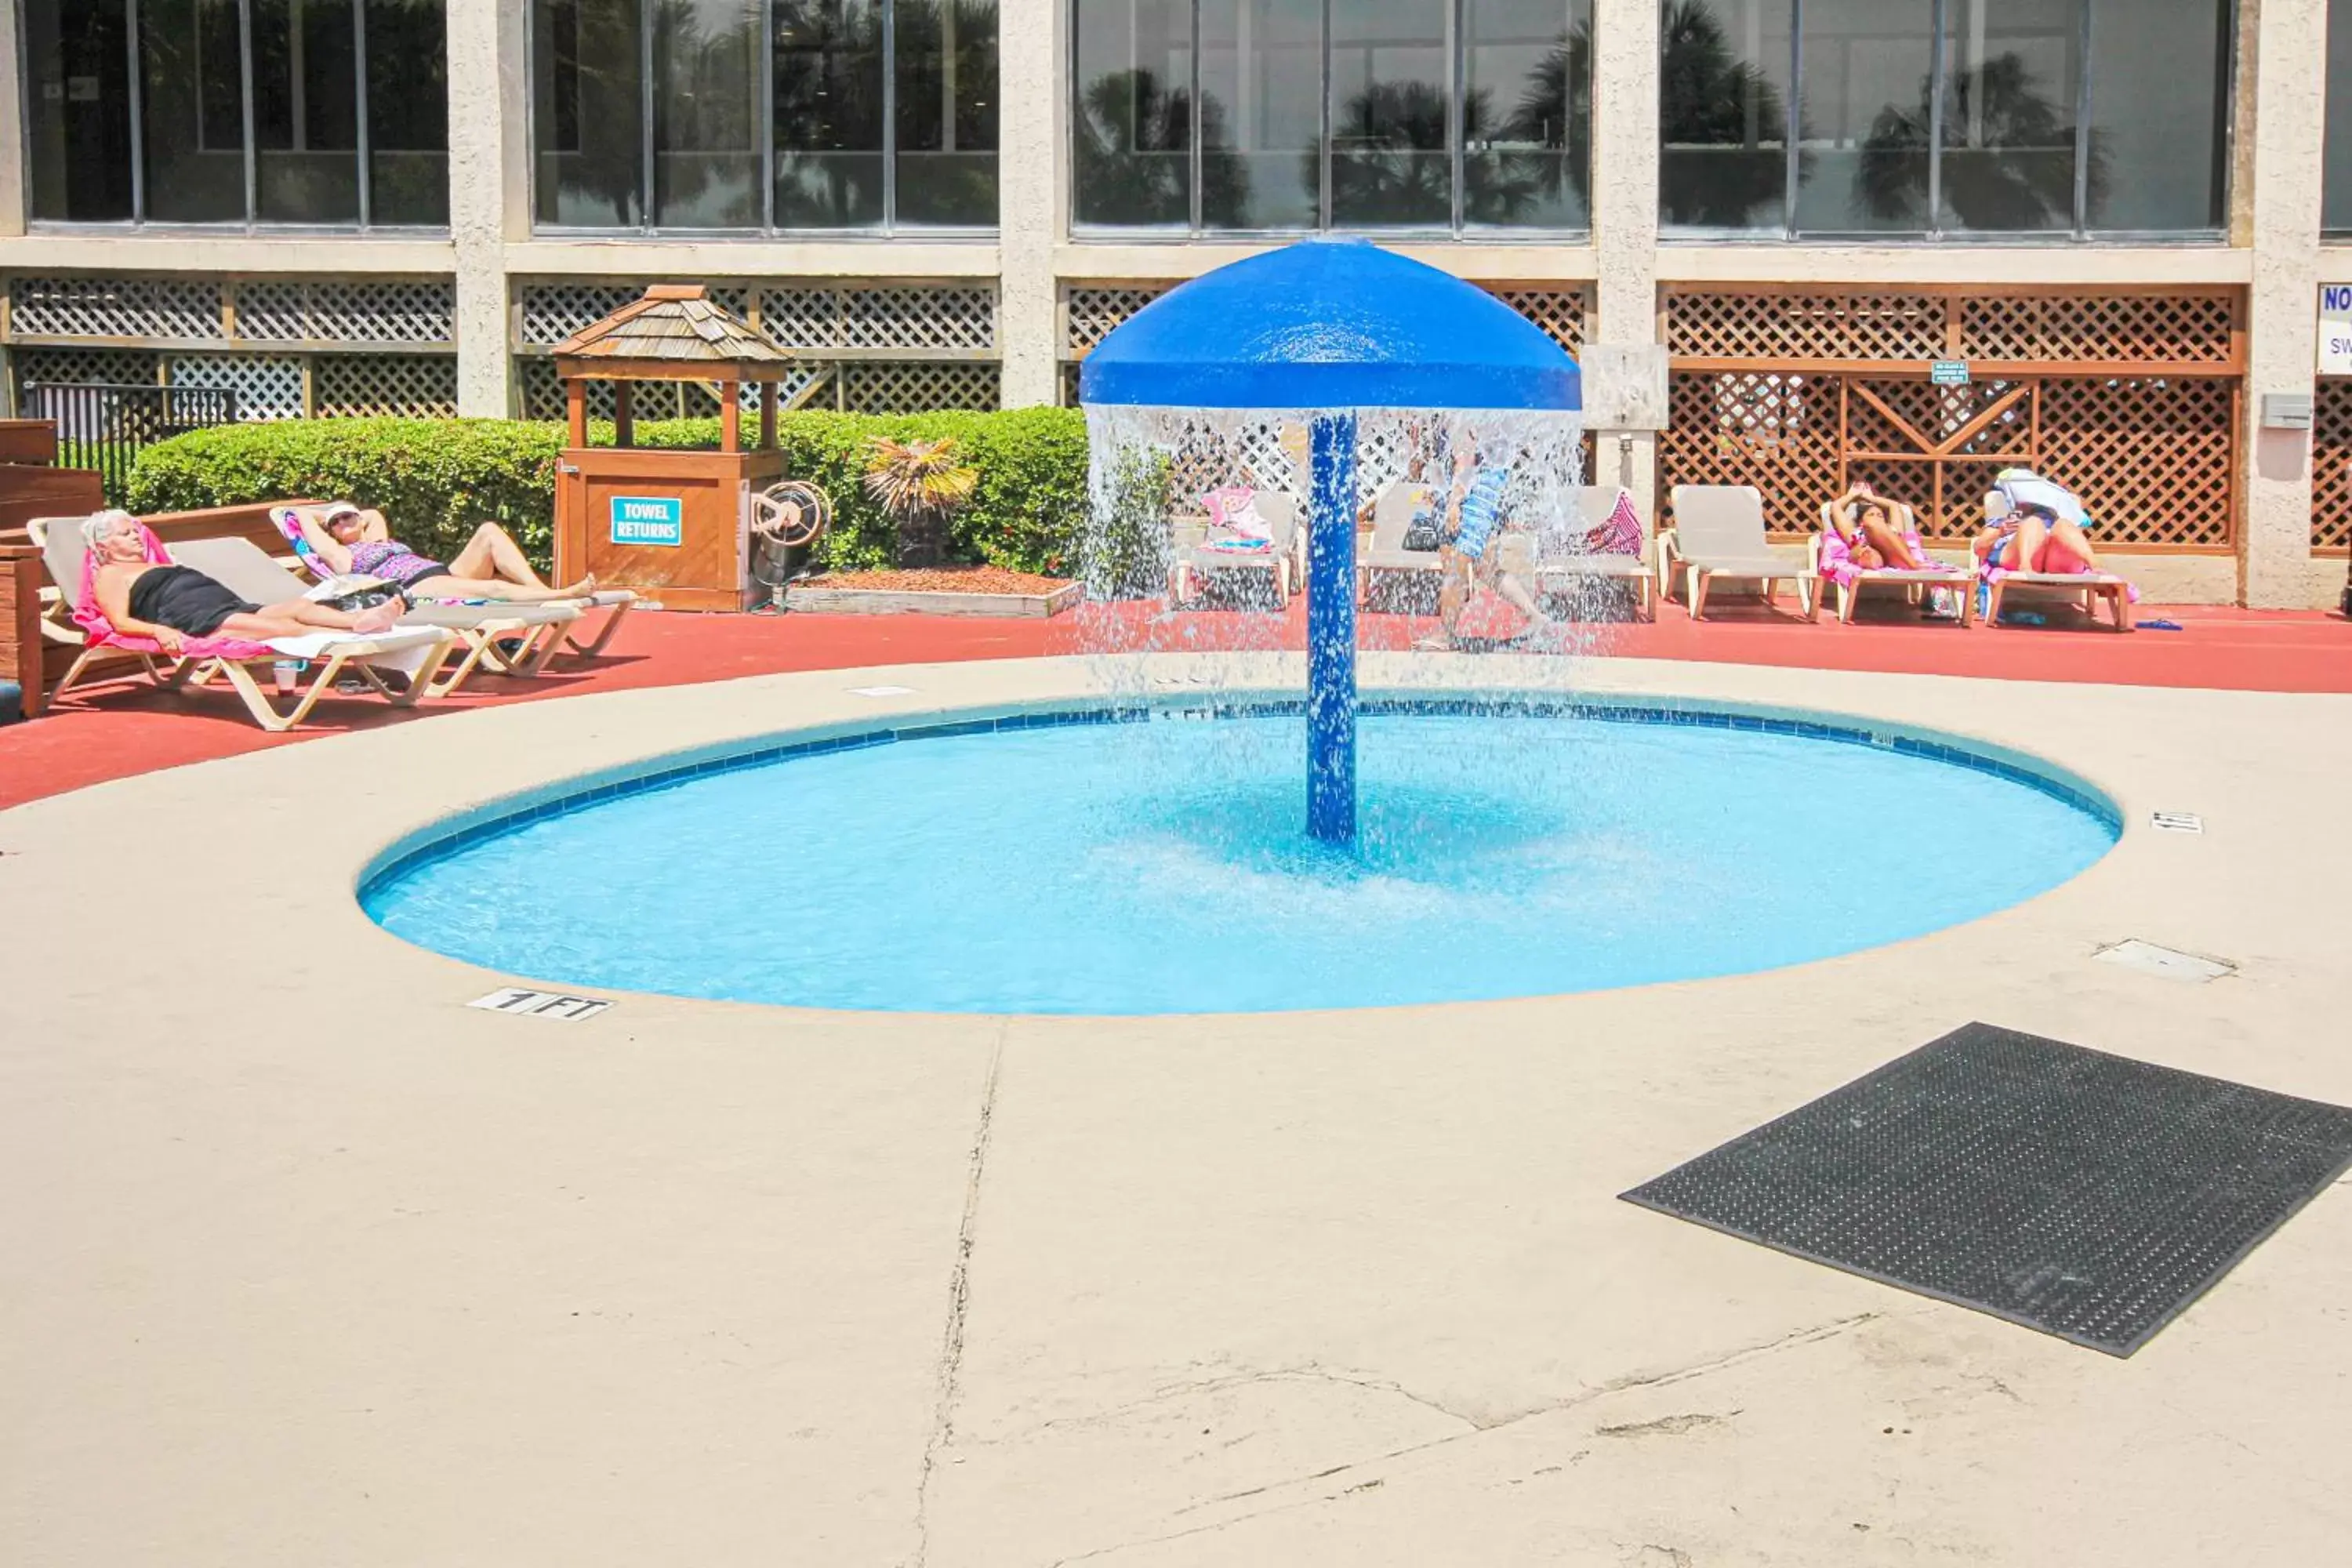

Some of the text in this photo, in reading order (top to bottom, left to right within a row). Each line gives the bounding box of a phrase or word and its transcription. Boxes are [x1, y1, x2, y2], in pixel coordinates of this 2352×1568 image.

[624, 503, 670, 521] TOWEL
[617, 521, 677, 539] RETURNS
[495, 993, 608, 1017] 1 FT
